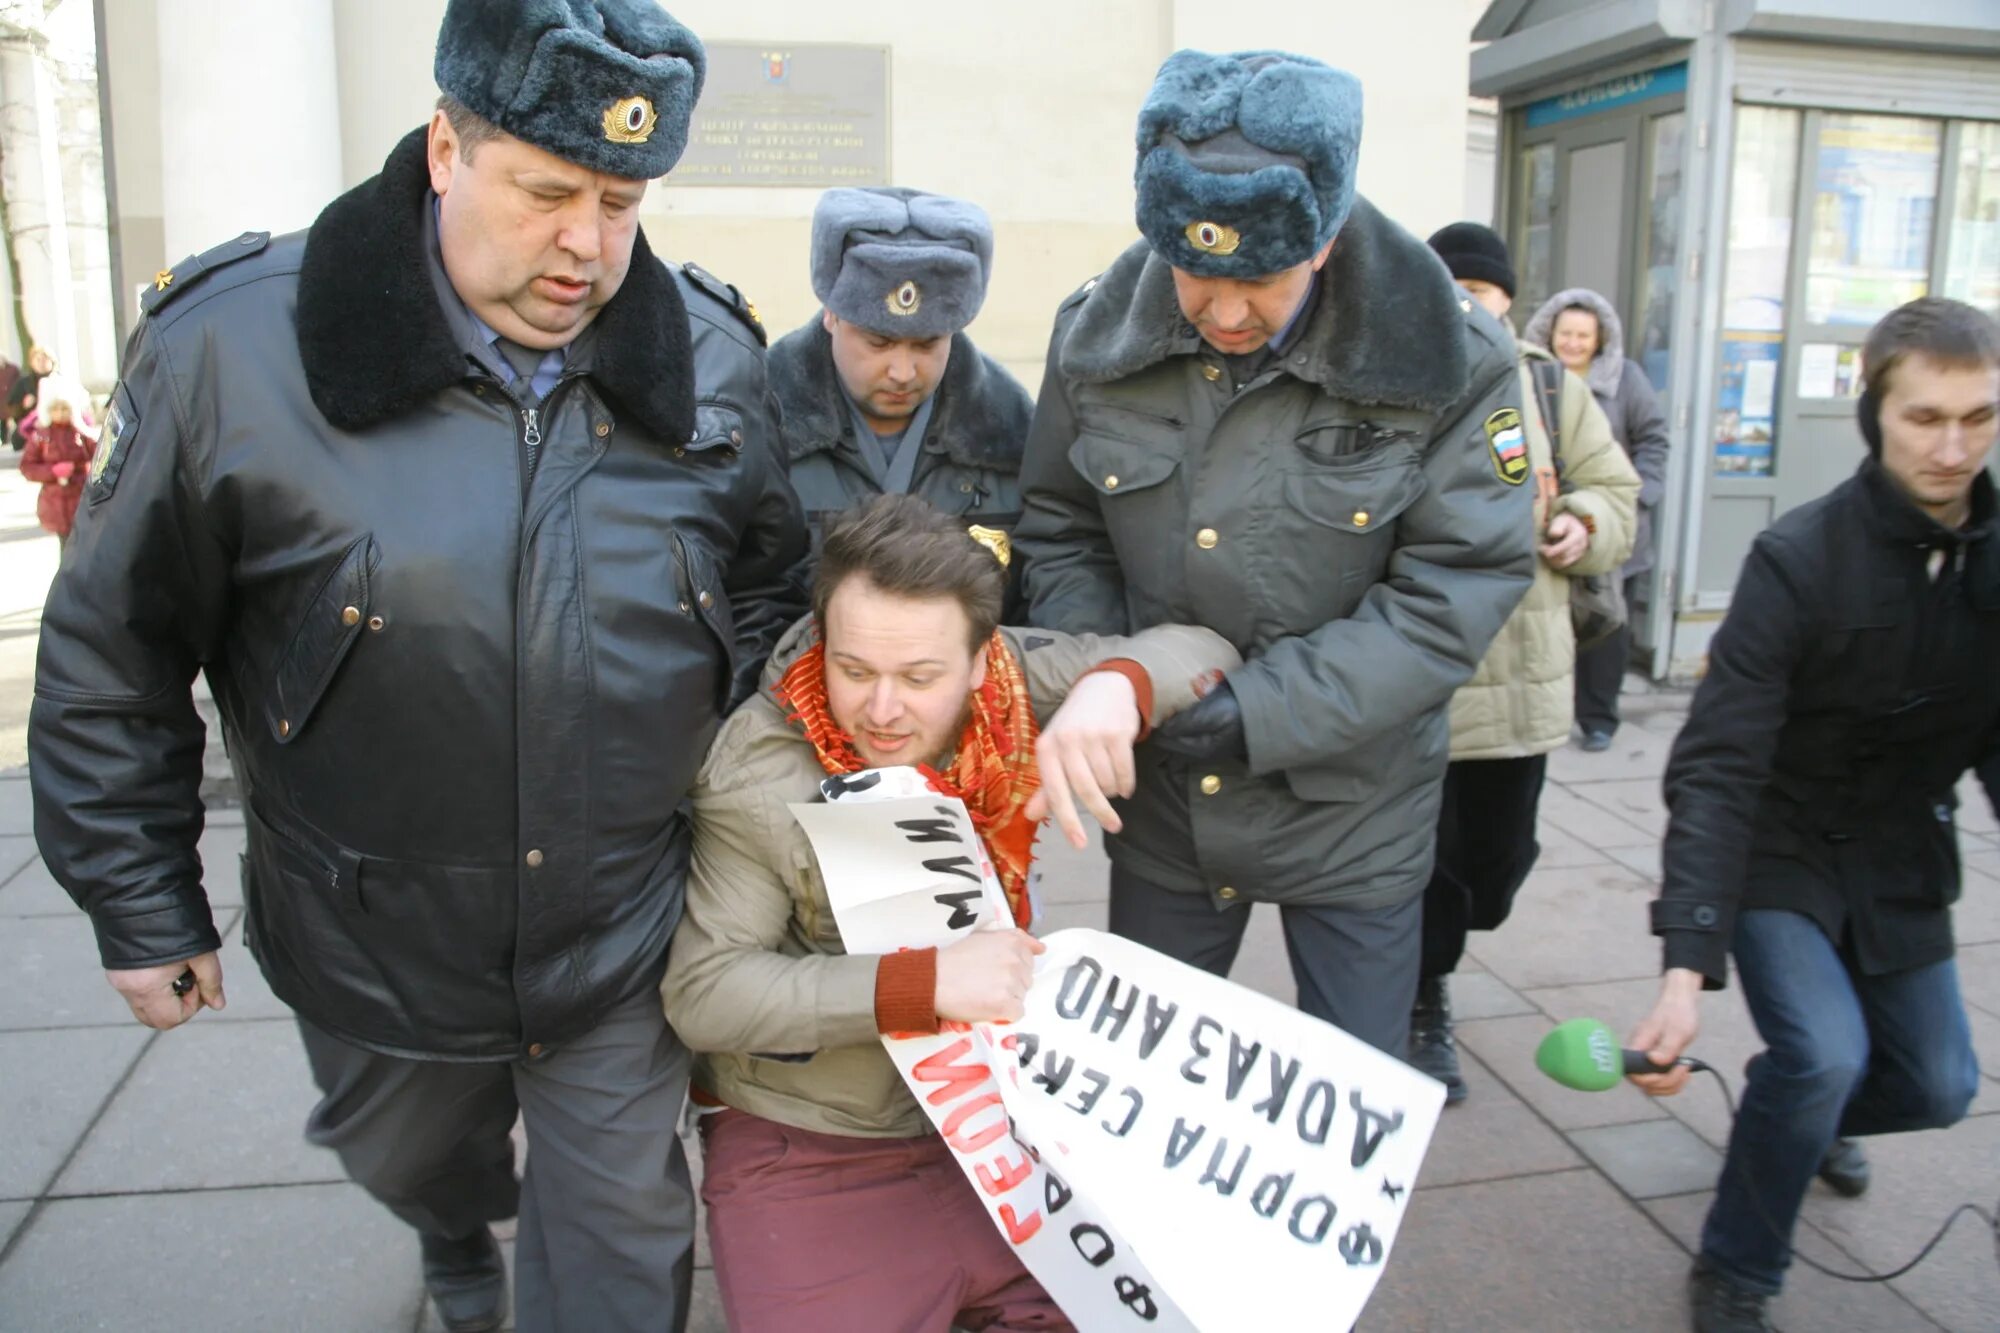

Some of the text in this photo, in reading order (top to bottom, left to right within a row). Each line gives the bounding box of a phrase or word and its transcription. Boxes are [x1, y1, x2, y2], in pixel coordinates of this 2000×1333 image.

[888, 1022, 1044, 1246] ГЕОИ
[1055, 955, 1404, 1168] ДОКАЗАНО
[1163, 1116, 1384, 1266] ФОРМА
